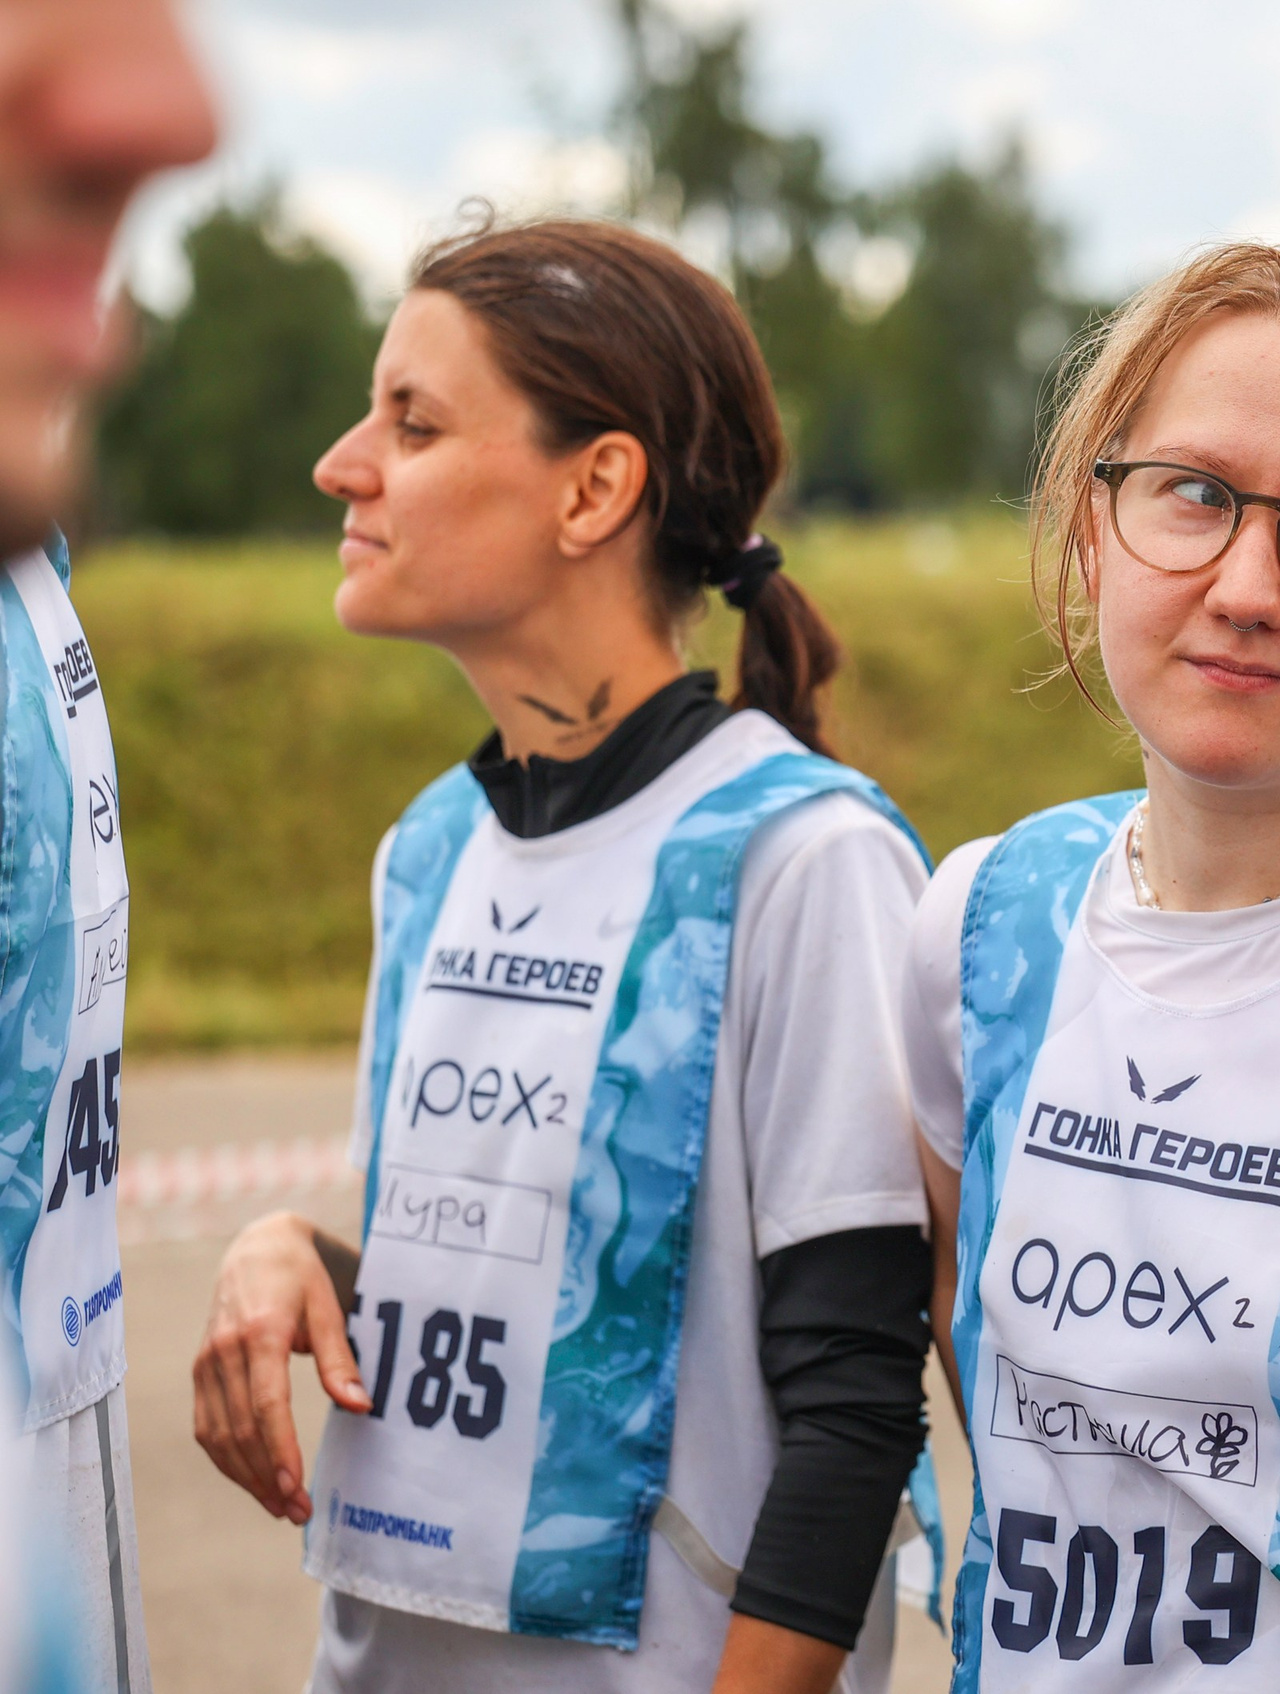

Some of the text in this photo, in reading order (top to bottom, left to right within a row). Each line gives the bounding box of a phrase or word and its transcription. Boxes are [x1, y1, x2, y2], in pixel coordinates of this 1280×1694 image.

[485, 951, 603, 996] ГЕРОЕВ
[1028, 1102, 1122, 1160] ГОНКА
[1011, 1237, 1230, 1344] apex
[991, 1507, 1262, 1666] 5019
